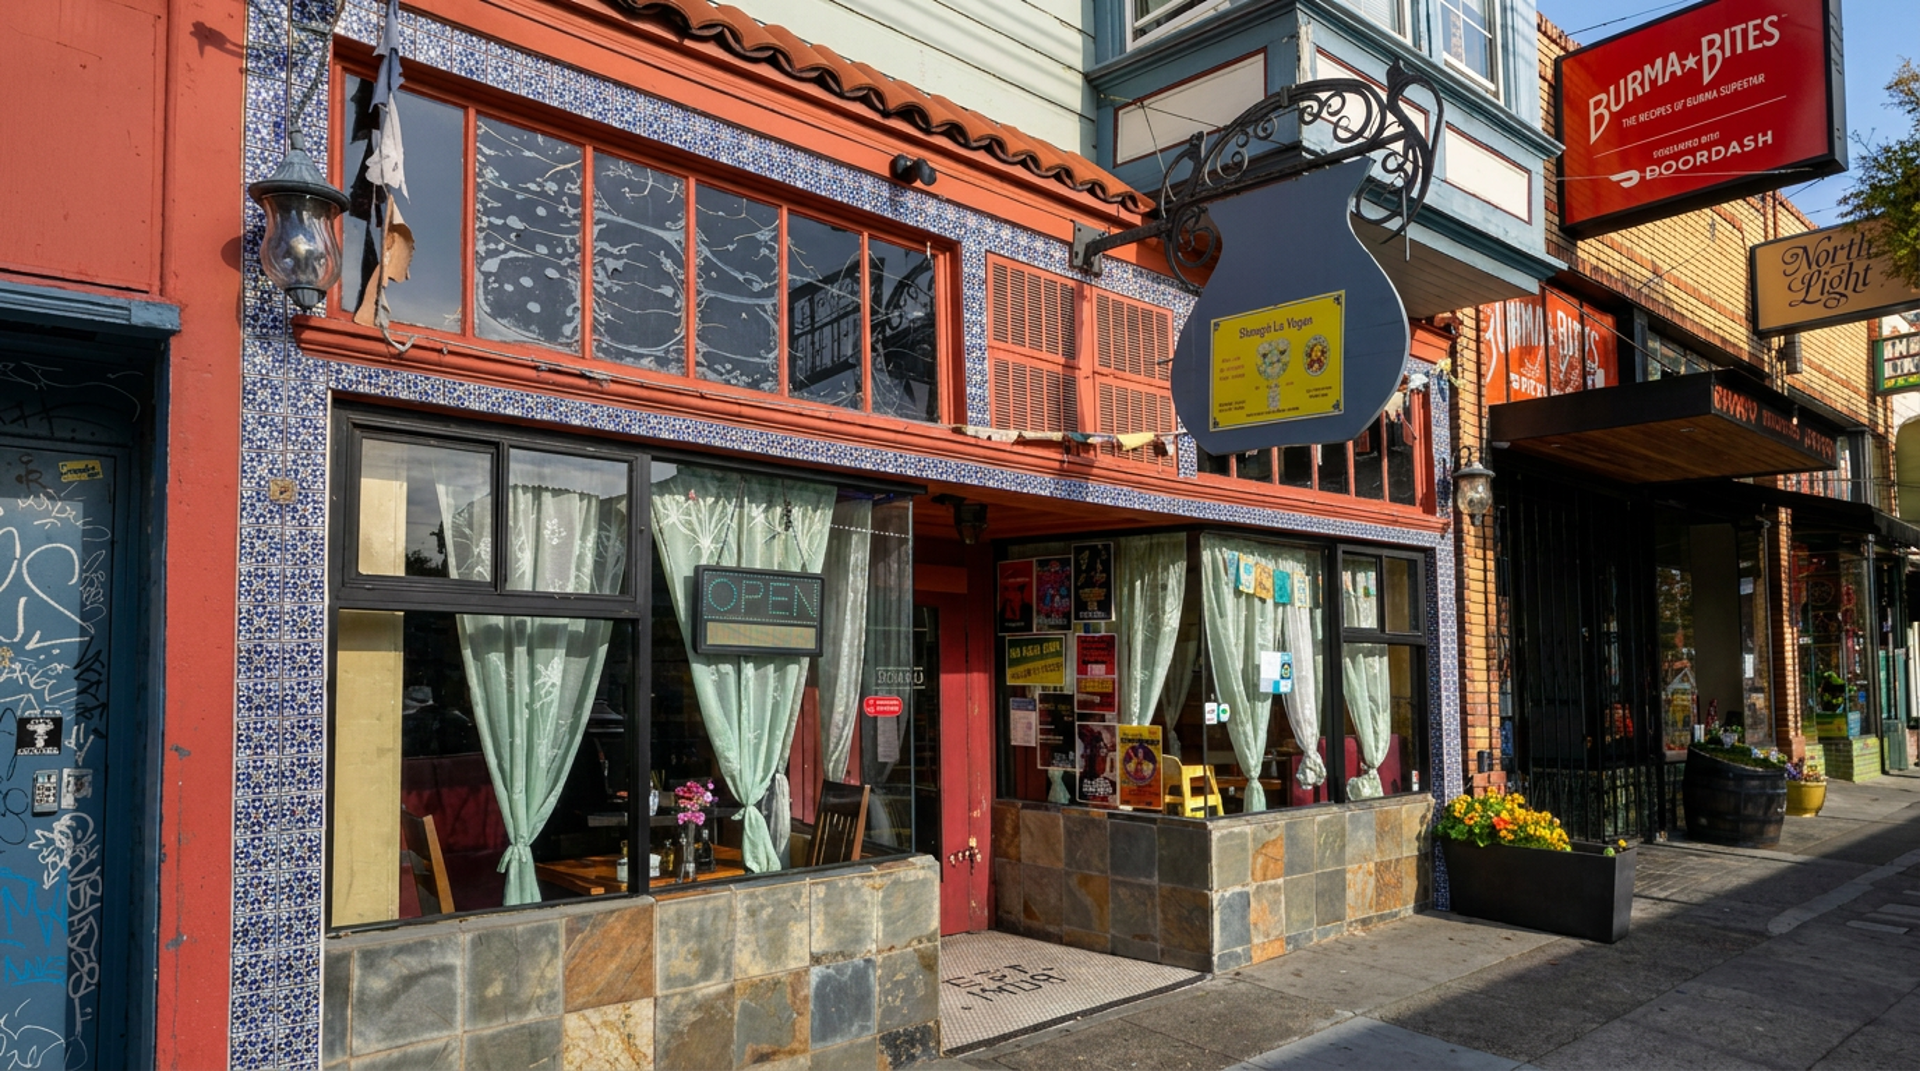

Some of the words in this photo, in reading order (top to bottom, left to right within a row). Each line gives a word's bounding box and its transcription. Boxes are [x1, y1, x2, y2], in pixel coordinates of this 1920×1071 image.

[1588, 51, 1684, 145] BURMA
[1701, 14, 1781, 86] BITES
[1646, 129, 1773, 180] DOORDASH
[1787, 262, 1873, 309] Light
[707, 577, 818, 618] OPEN
